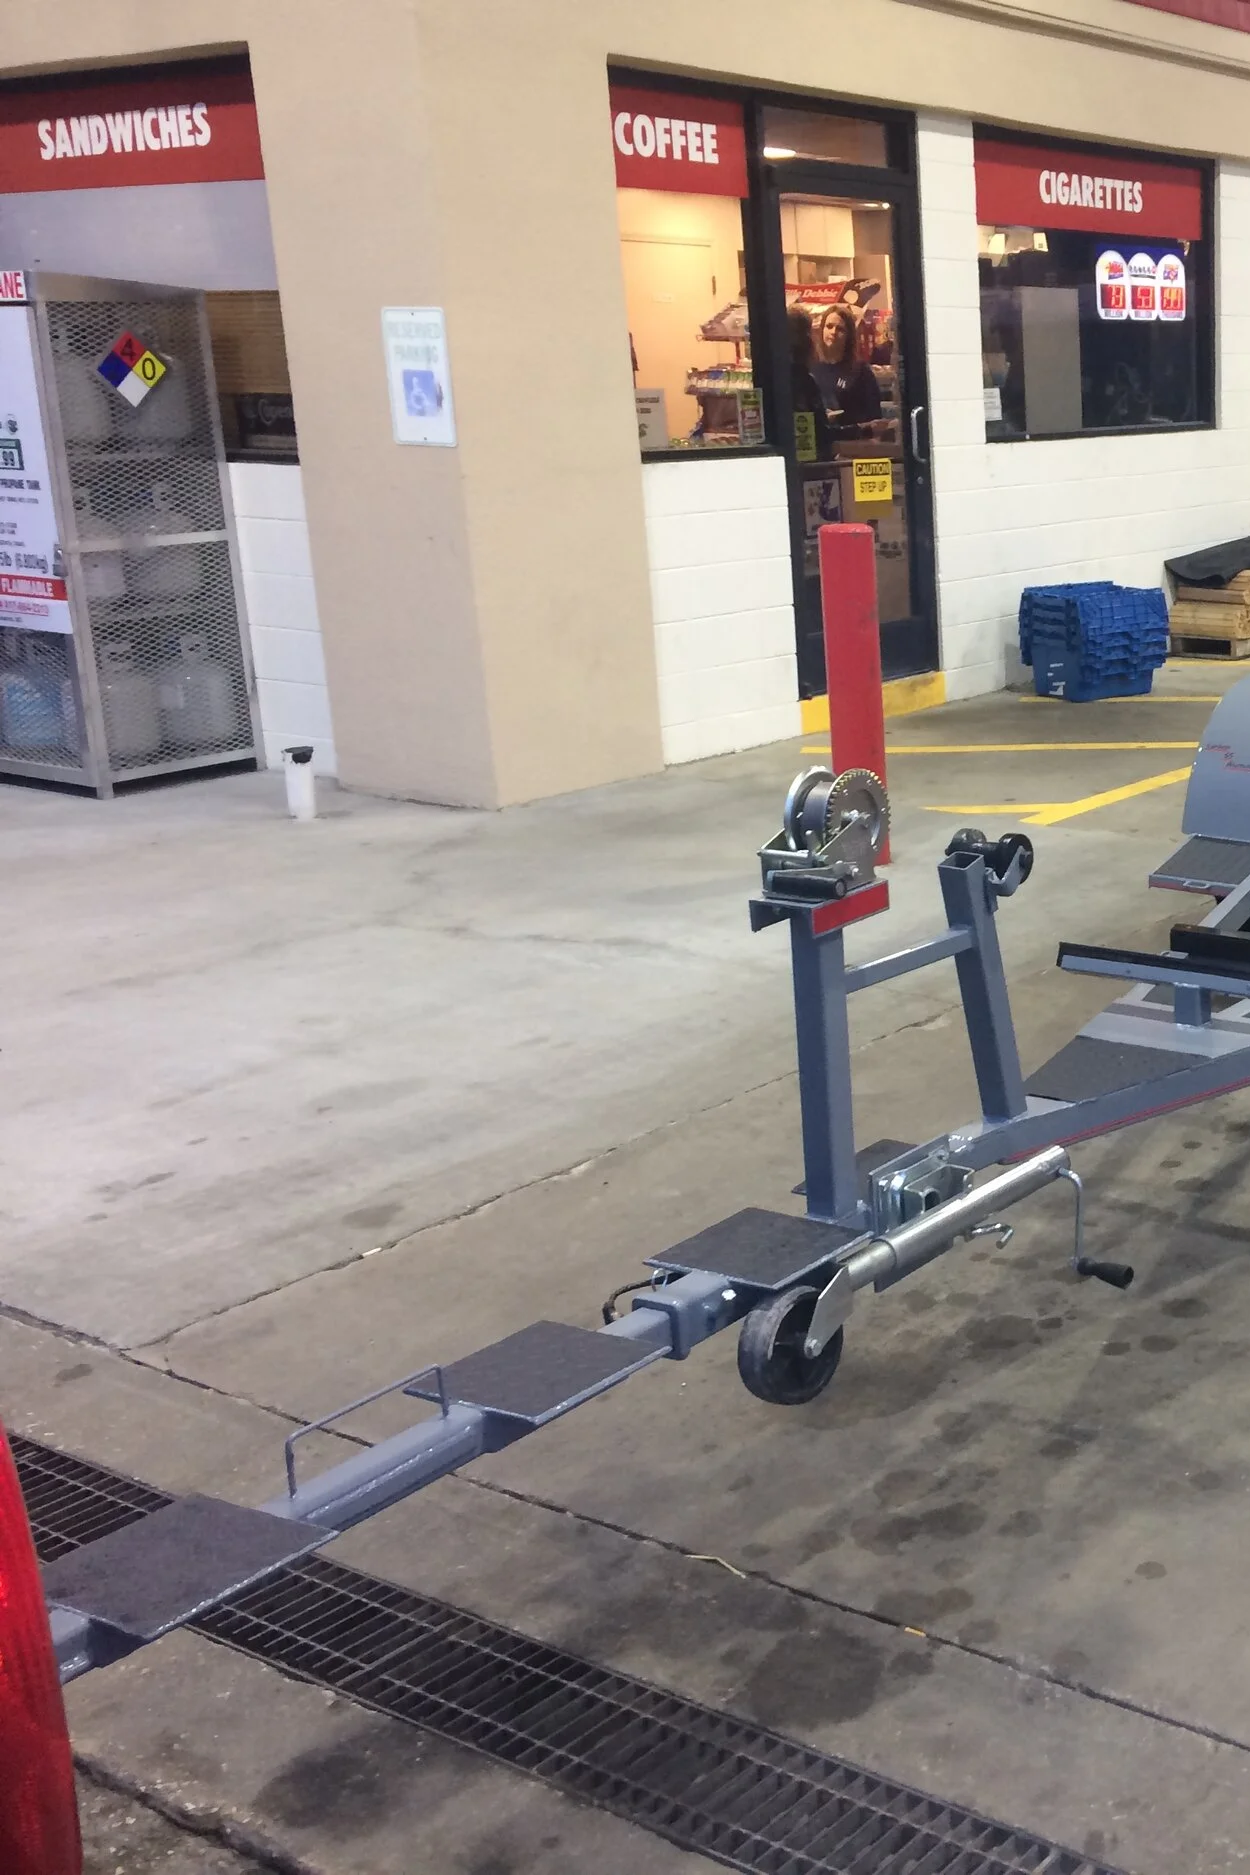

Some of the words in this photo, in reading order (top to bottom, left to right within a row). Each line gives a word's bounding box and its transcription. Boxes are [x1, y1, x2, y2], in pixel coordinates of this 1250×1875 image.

[37, 103, 211, 161] SANDWICHES
[613, 111, 720, 165] COFFEE
[1038, 169, 1144, 214] CIGARETTES
[802, 288, 838, 299] Debbie
[387, 321, 441, 340] RESERVED
[120, 338, 137, 361] 4
[142, 357, 156, 381] 0
[856, 463, 890, 476] CAUTION
[860, 481, 877, 493] STEP
[878, 480, 887, 492] UP
